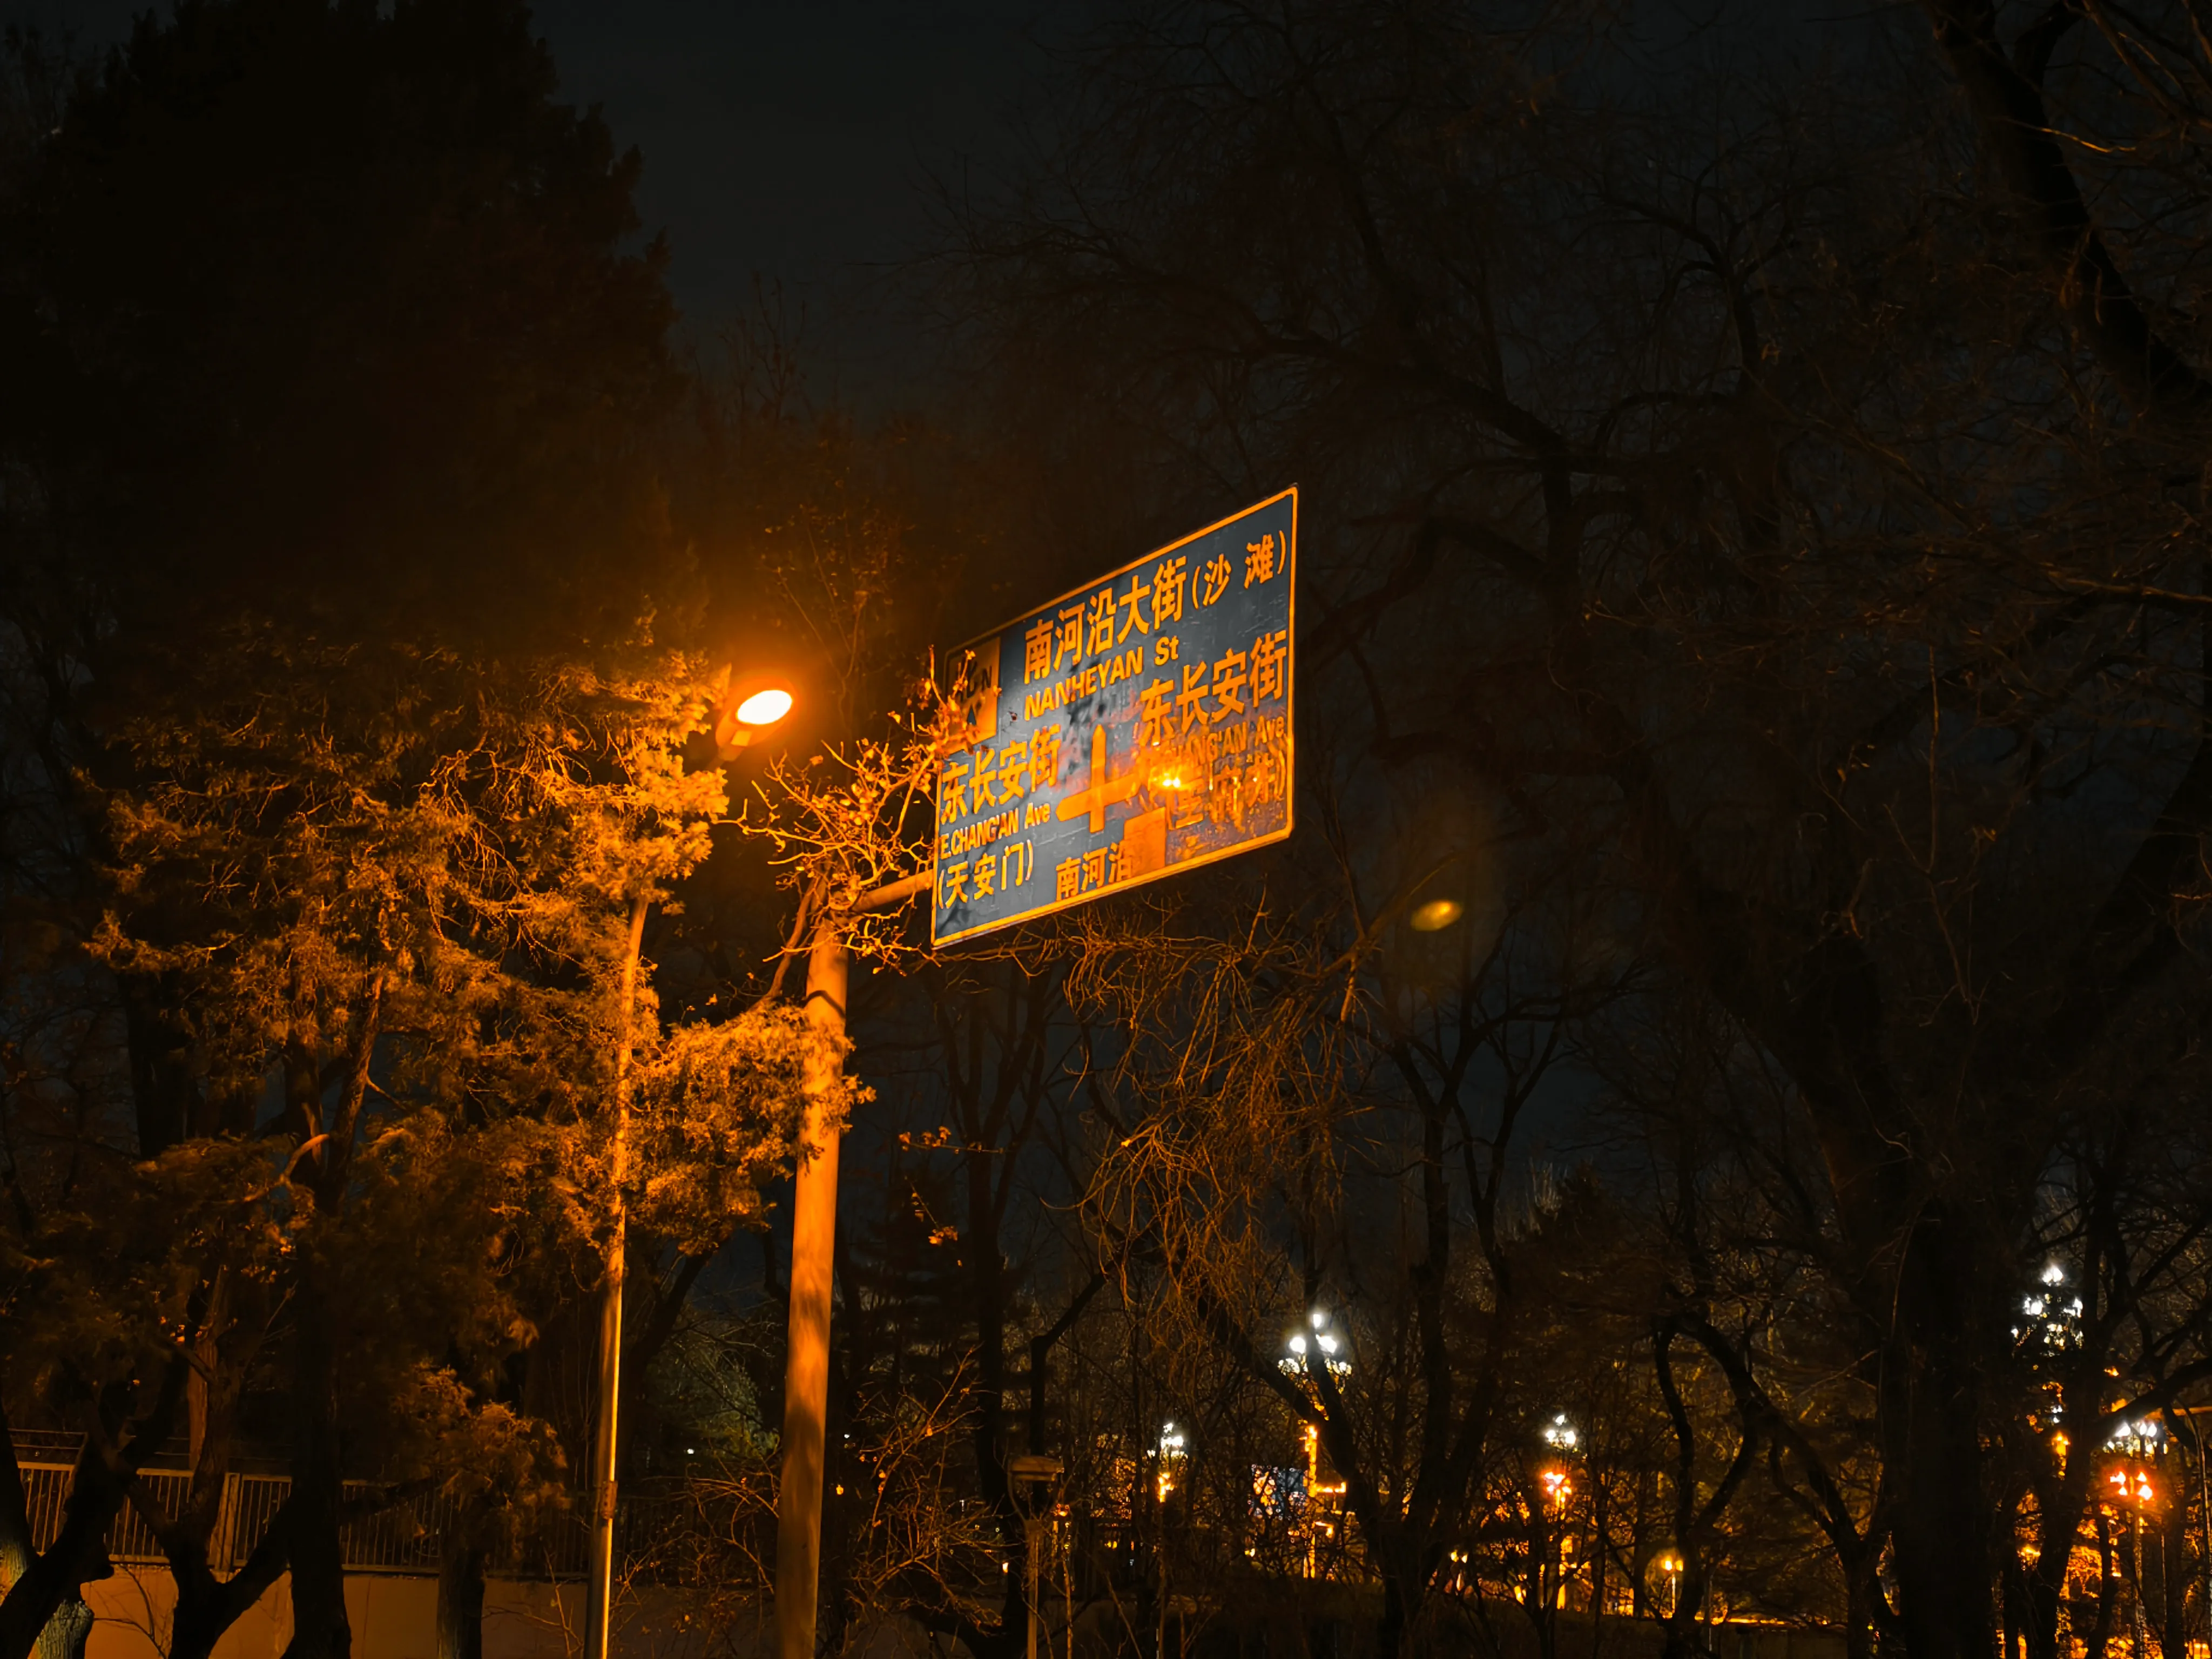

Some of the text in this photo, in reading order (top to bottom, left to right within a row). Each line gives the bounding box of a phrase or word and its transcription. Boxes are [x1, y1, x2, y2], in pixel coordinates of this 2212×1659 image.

[1024, 556, 1186, 684] 南河沿大街
[1024, 636, 1179, 720] NANHEYAN St
[1139, 630, 1286, 746] 东长安街
[1255, 716, 1284, 746] Ave
[941, 724, 1061, 825] 东长安街
[1024, 802, 1050, 830] Ave
[938, 840, 1033, 909] (天安门)
